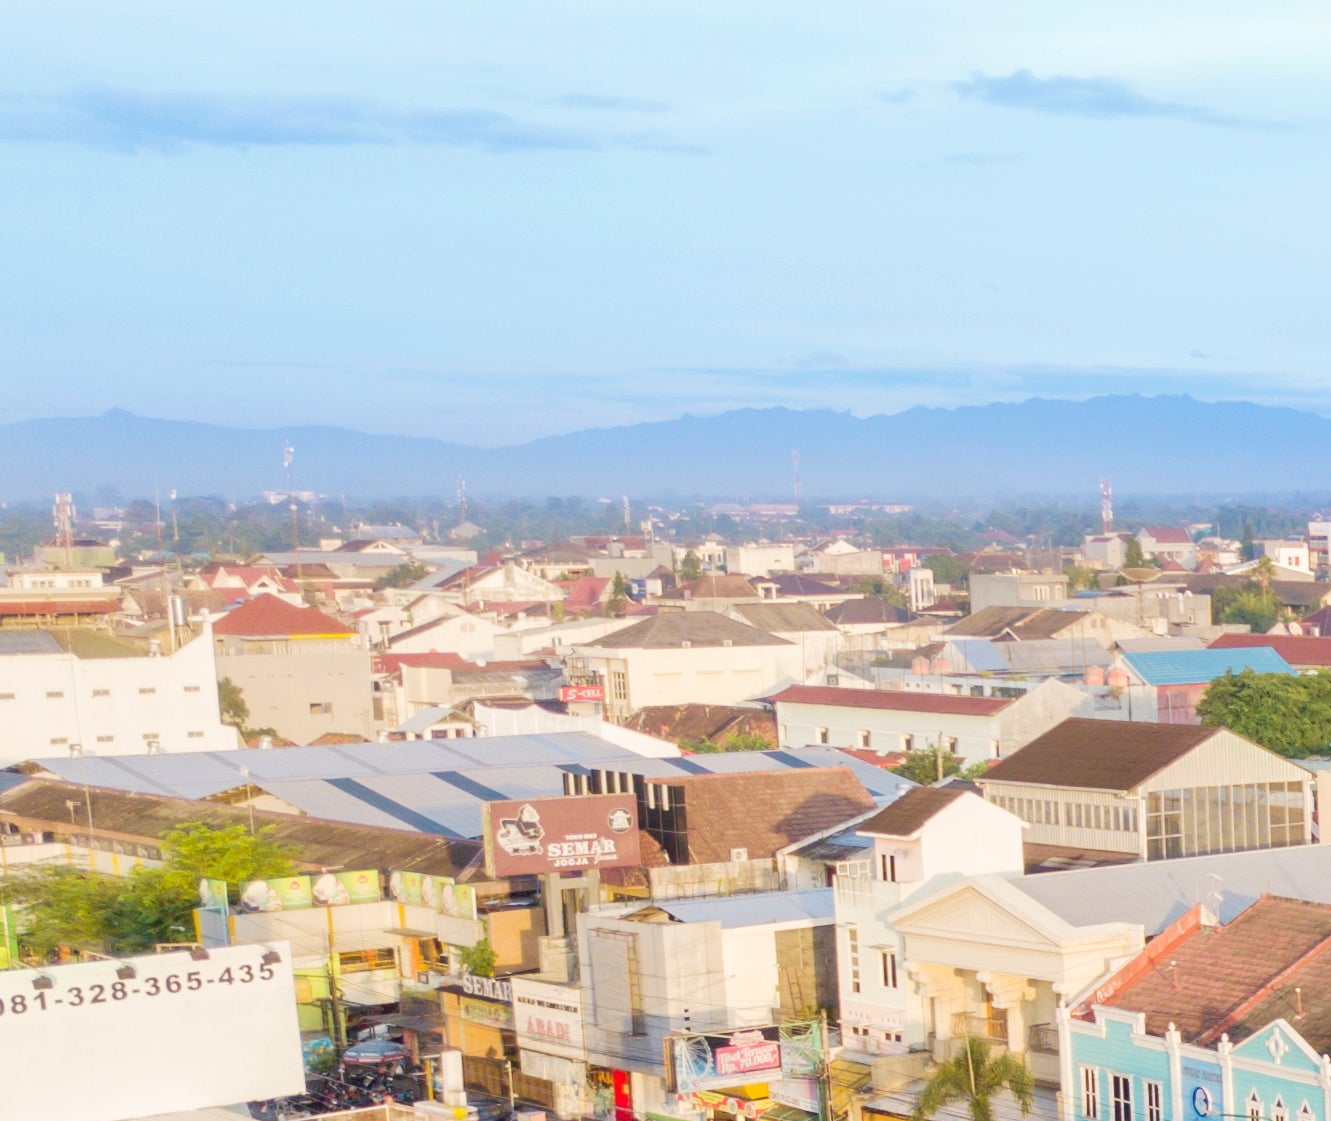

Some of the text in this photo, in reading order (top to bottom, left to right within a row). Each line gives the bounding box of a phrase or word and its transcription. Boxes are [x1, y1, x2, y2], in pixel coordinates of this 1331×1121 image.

[548, 838, 616, 857] SEMAR
[554, 858, 589, 867] JOGJA
[463, 974, 512, 1001] SEMAR
